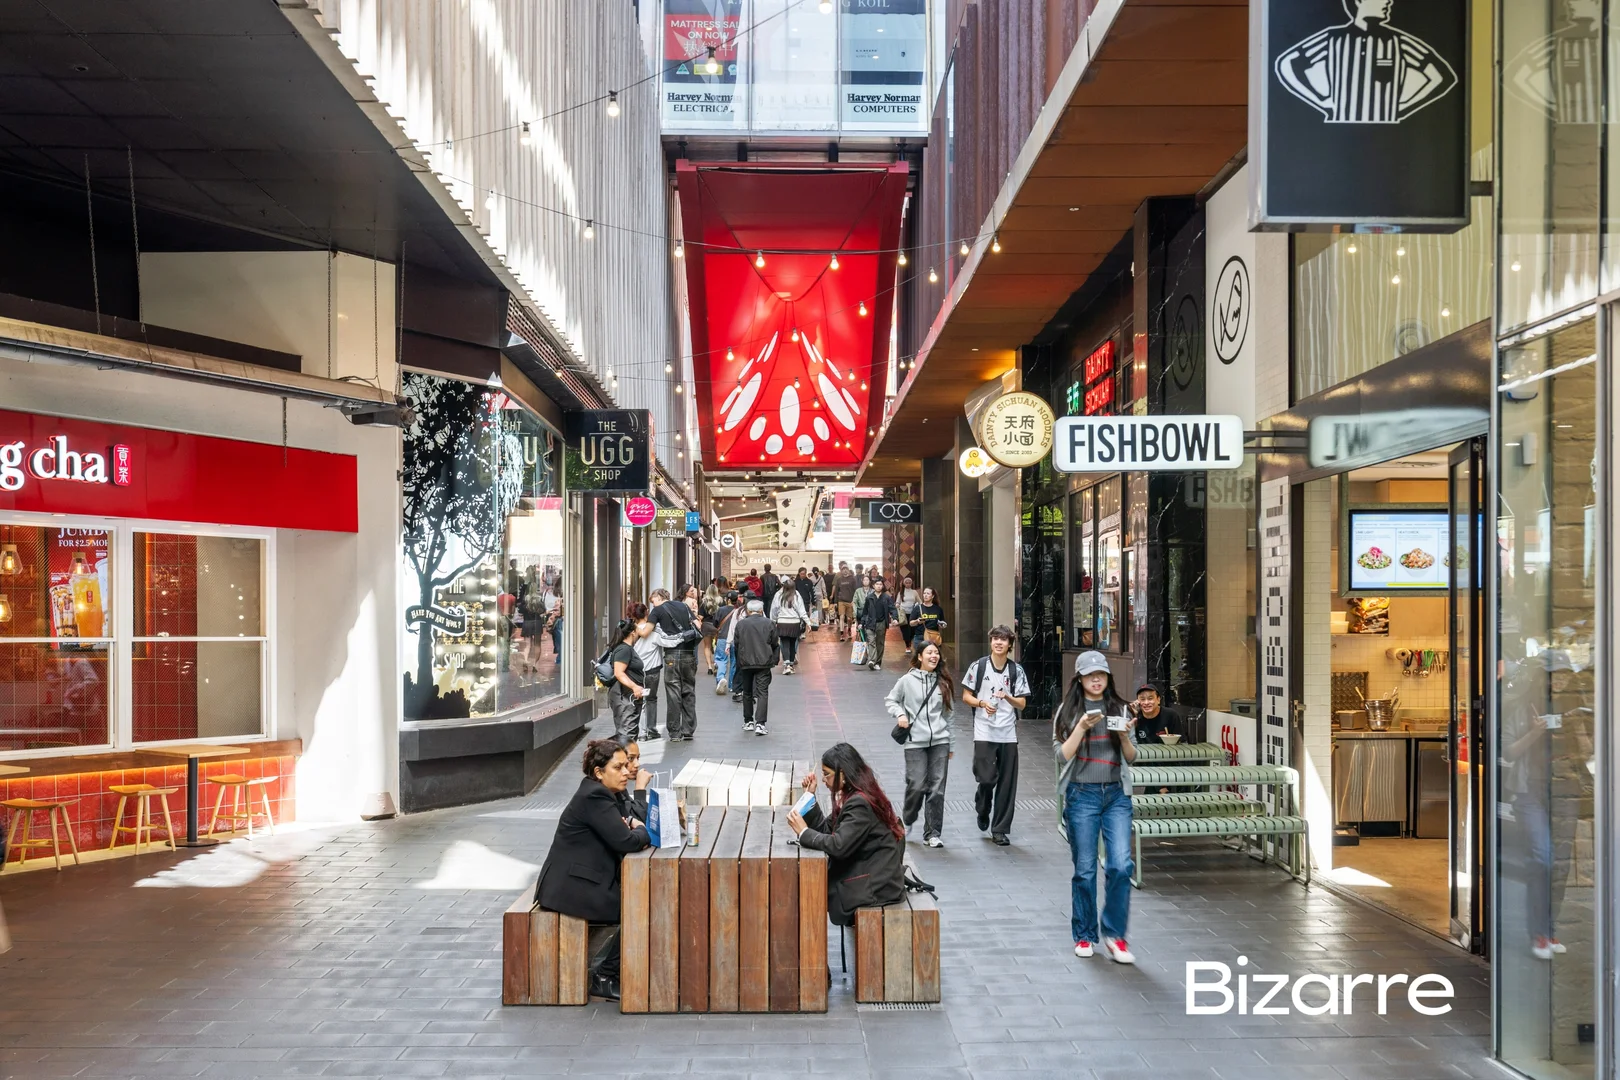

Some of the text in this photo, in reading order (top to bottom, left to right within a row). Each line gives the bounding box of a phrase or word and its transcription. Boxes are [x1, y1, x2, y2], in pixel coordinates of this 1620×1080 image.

[670, 20, 740, 29] MATTRESS SAL
[688, 31, 730, 39] ON NOW
[667, 92, 702, 102] Harvey
[847, 93, 882, 103] Harvey
[853, 105, 917, 113] COMPUTERS
[598, 421, 617, 431] THE
[986, 397, 1052, 448] DAINTY SICHUAN NOODLES
[1004, 415, 1035, 429] 天府
[1069, 422, 1230, 463] FISHBOWL
[581, 435, 634, 466] UGG
[33, 435, 108, 483] cha
[594, 470, 621, 480] SHOP
[58, 527, 108, 538] JUMB
[58, 539, 75, 547] FOR
[75, 539, 91, 548] $2.5
